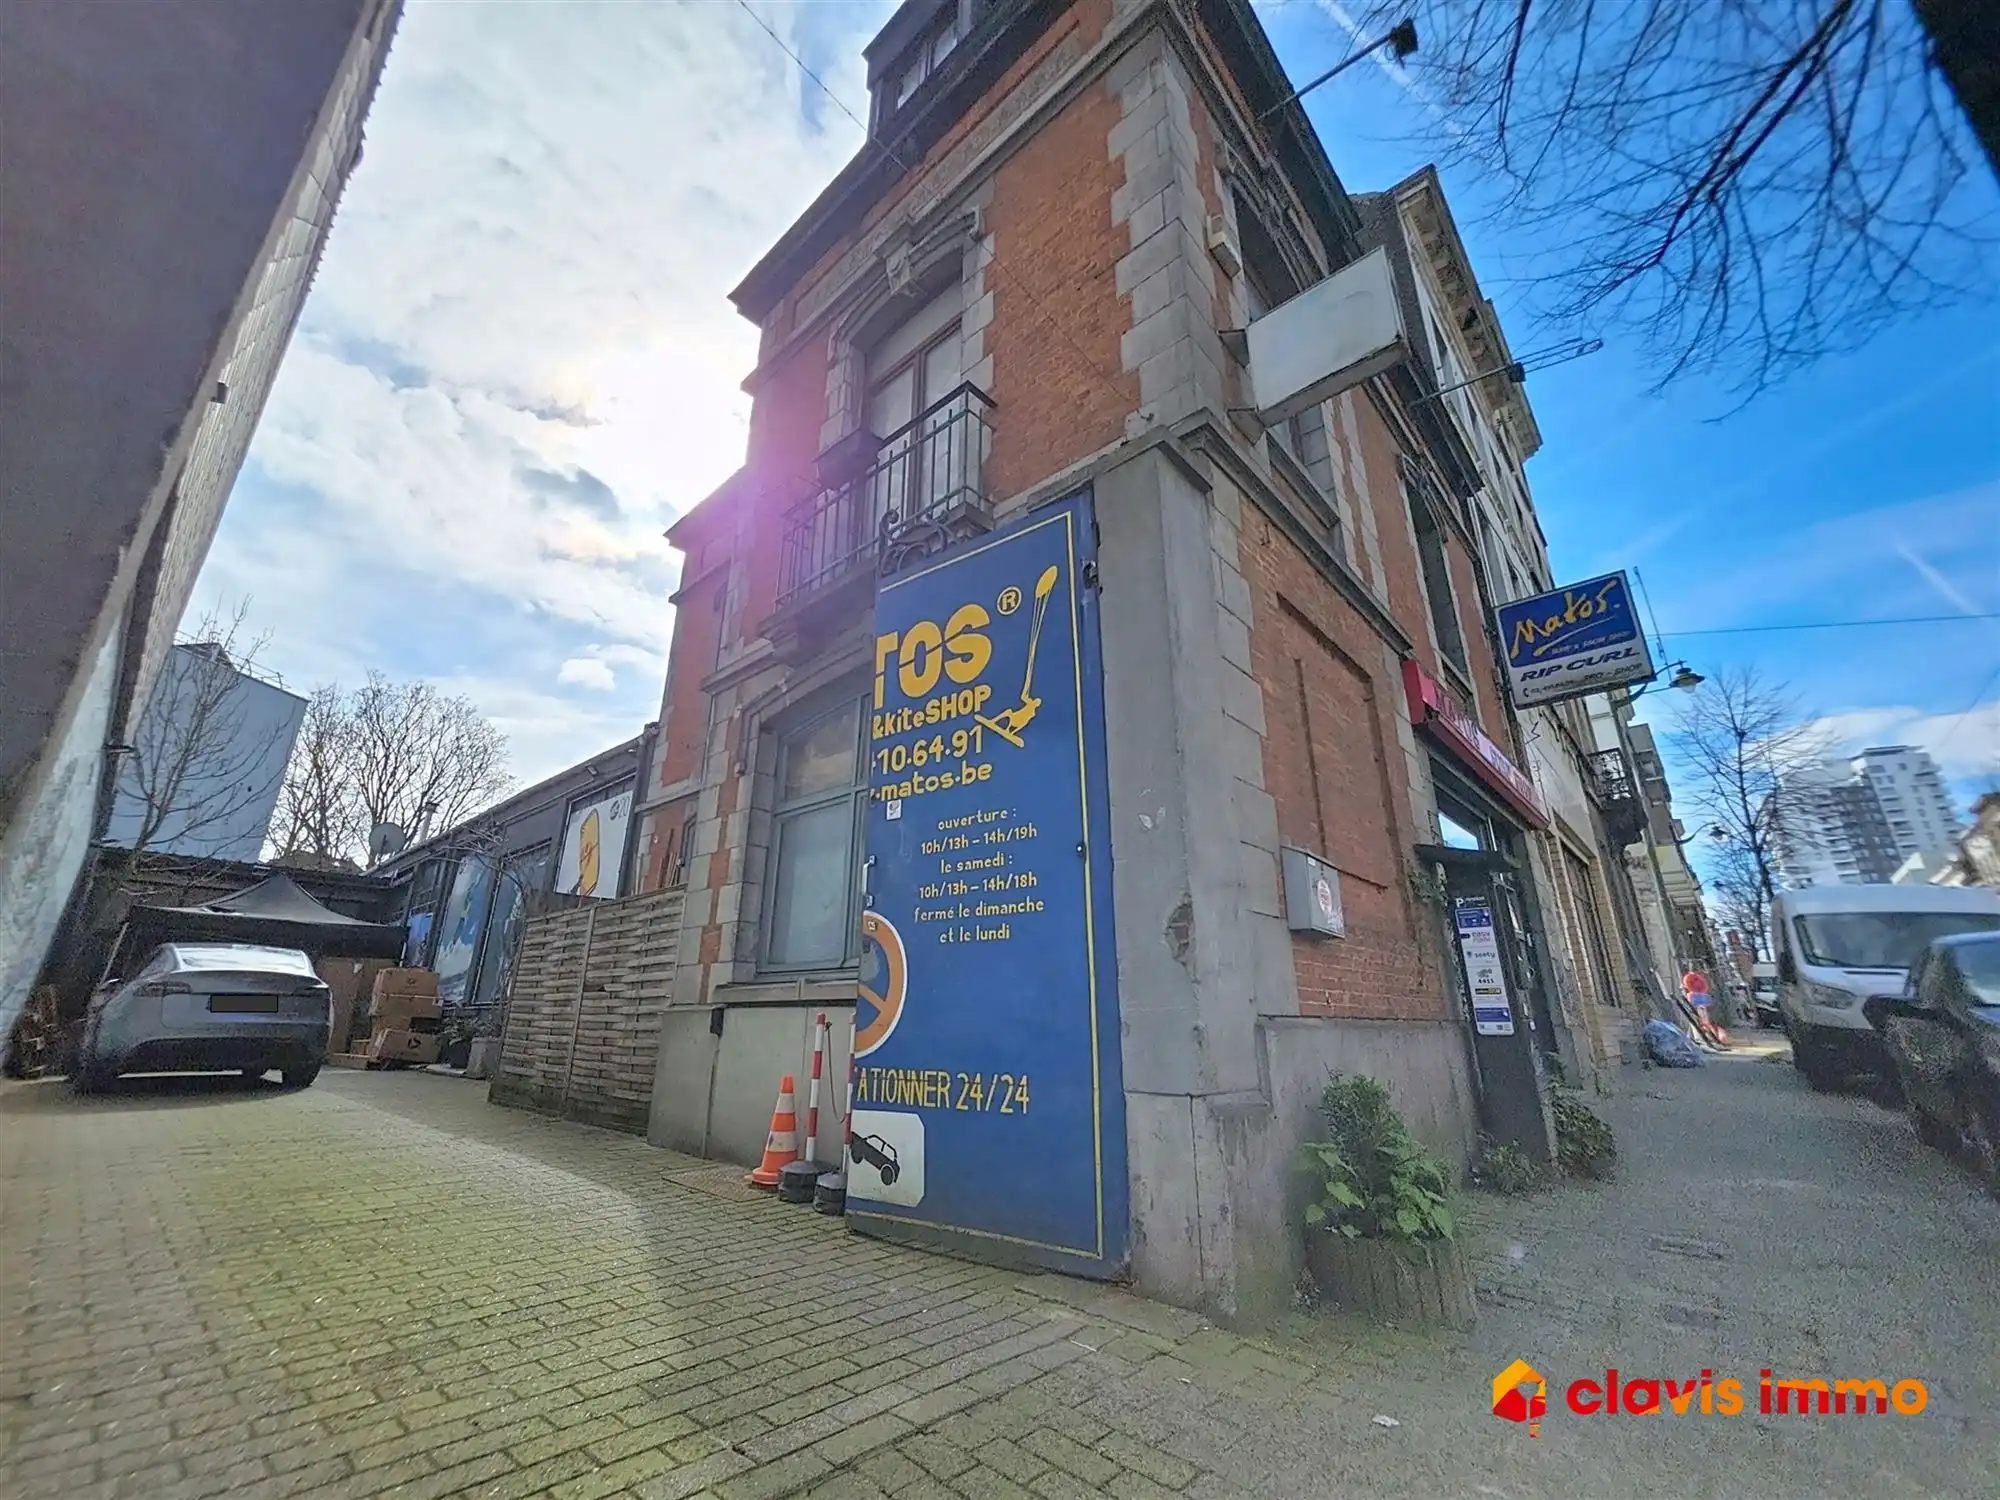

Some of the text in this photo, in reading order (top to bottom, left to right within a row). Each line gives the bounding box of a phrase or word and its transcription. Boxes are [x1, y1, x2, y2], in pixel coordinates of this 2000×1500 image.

[1520, 647, 1640, 682] RIP CURL
[870, 724, 982, 778] 10.64.91
[921, 834, 969, 855] 10h/13h
[984, 822, 1038, 845] 14h/19h
[941, 859, 952, 873] le
[957, 851, 1005, 871] samedi
[919, 880, 968, 899] 10h/13h
[983, 871, 1038, 893] 14h/18h
[914, 896, 1045, 922] fermé le dimanche
[940, 922, 1010, 943] et le lundi
[853, 1066, 1030, 1114] ATIONNER 24/24
